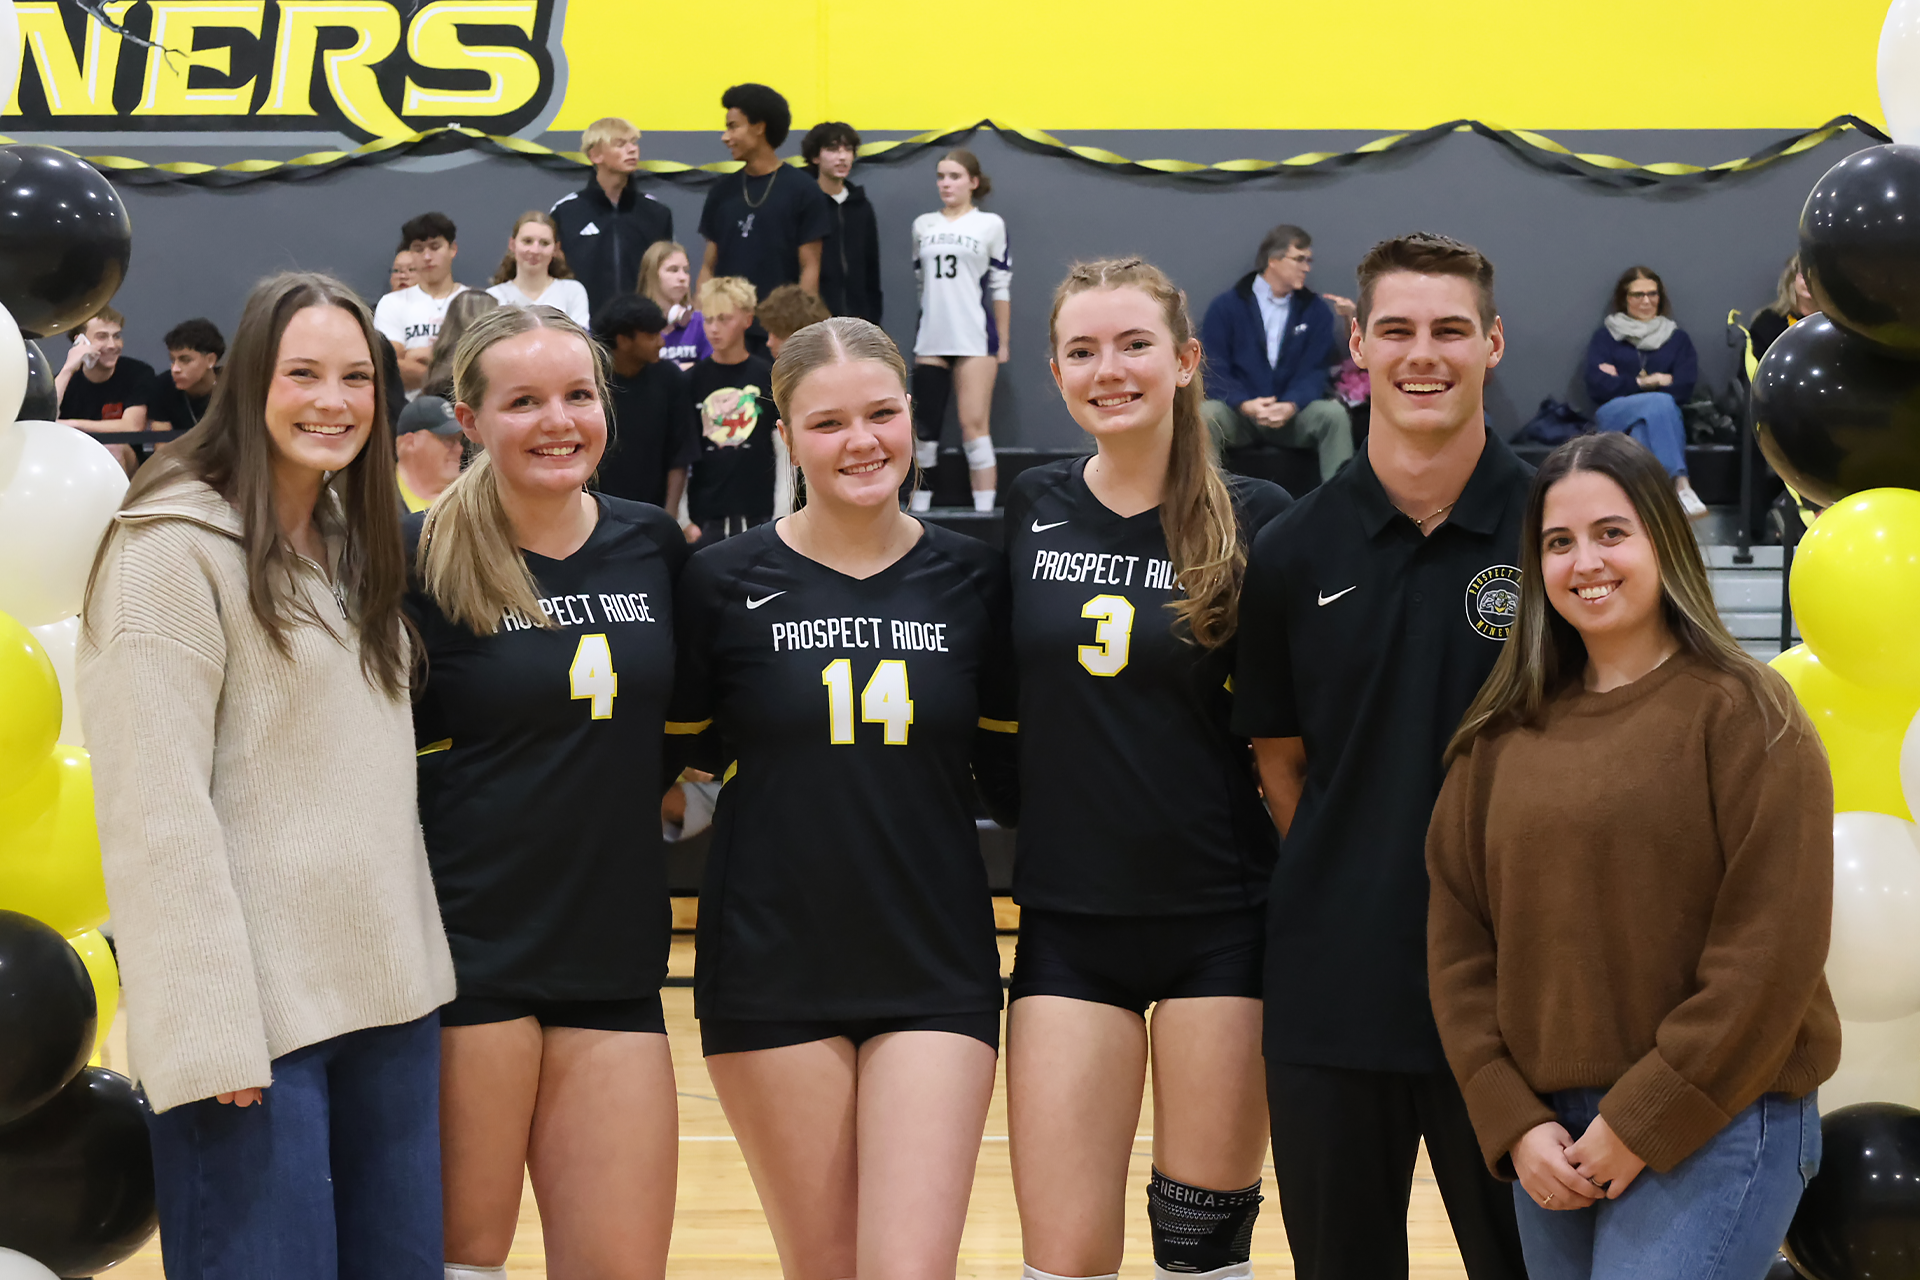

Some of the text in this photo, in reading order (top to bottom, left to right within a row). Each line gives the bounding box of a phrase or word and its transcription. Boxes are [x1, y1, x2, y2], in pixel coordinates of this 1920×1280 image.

[934, 254, 957, 279] 13
[405, 323, 430, 341] SAN
[1032, 550, 1185, 590] PROSPECT RID
[1468, 568, 1514, 595] PROSPECT
[491, 593, 656, 634] ROPECT RIDGE
[772, 617, 949, 653] PROSPECT RIDGE
[1077, 593, 1136, 677] 3
[569, 633, 618, 720] 4
[821, 658, 914, 745] 14
[1160, 1180, 1215, 1207] NEENCA
